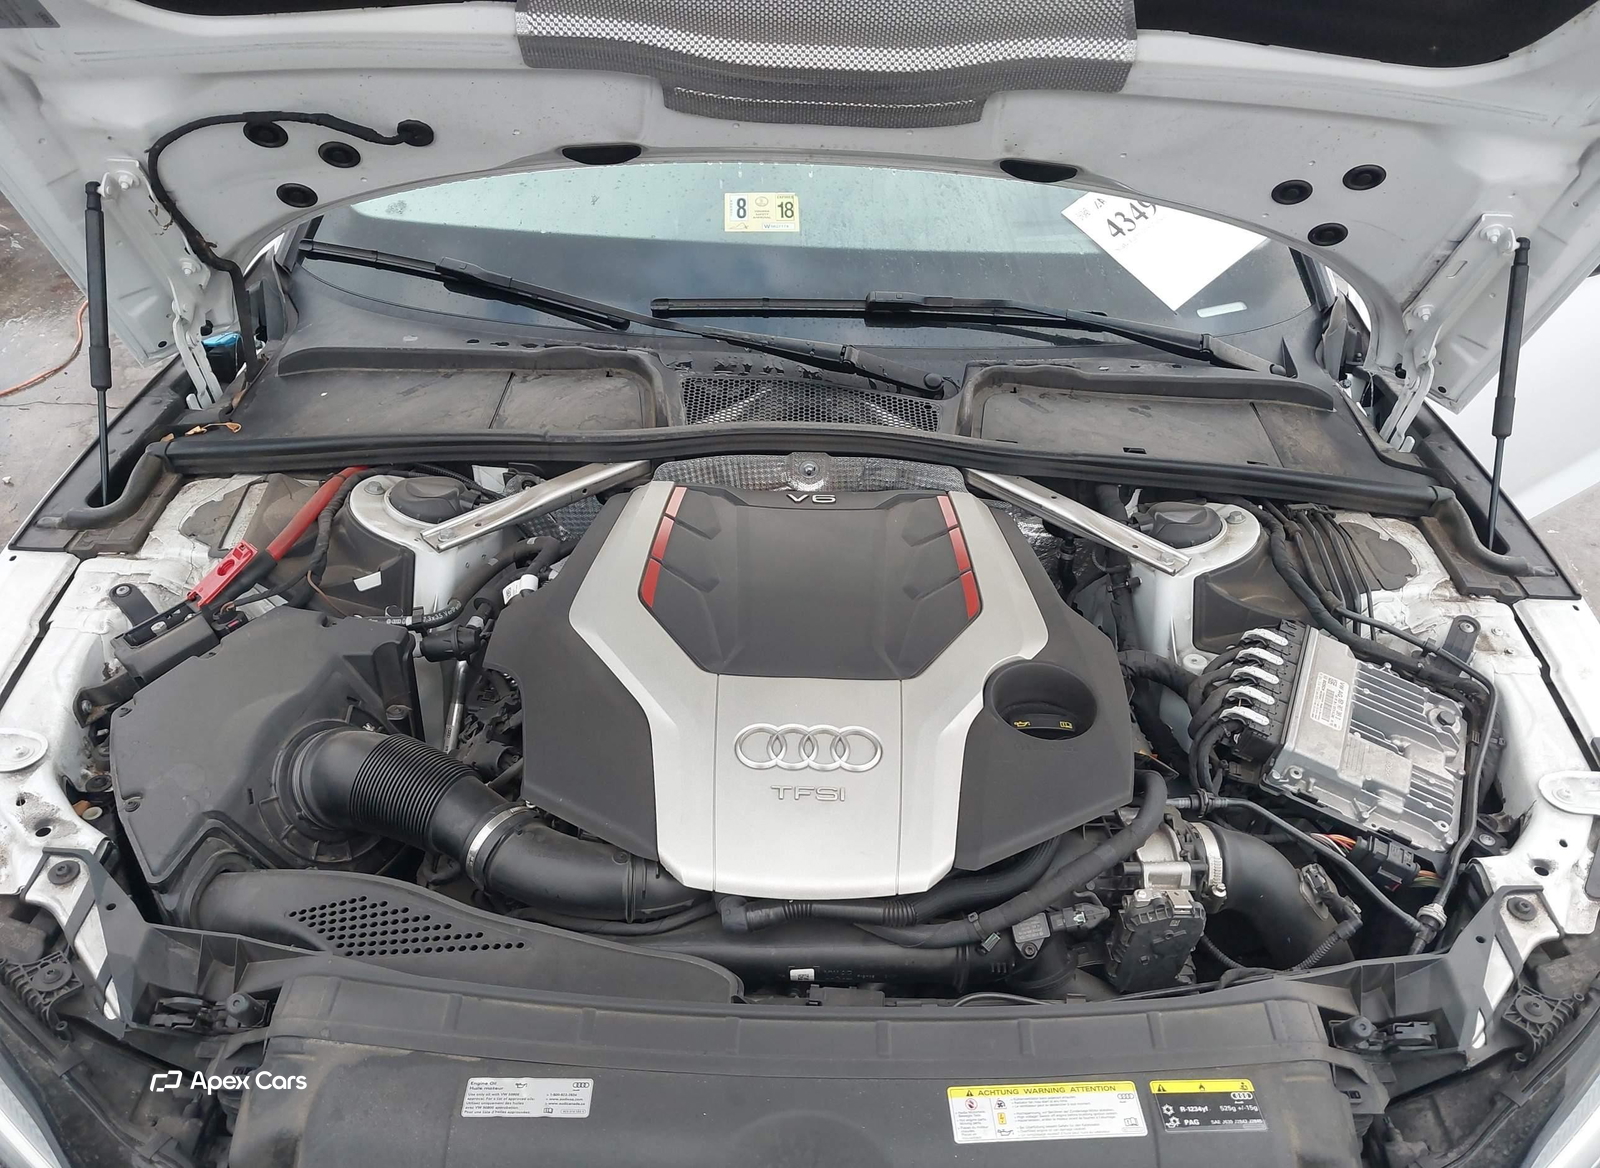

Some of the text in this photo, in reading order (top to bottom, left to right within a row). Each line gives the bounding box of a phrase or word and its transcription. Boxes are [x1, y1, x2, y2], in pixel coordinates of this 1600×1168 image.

[737, 198, 747, 218] 8
[777, 201, 794, 218] 18
[786, 493, 836, 504] V6
[770, 785, 846, 802] TFSI
[977, 1085, 1116, 1097] ACHTUNG WARNING ATTENTION
